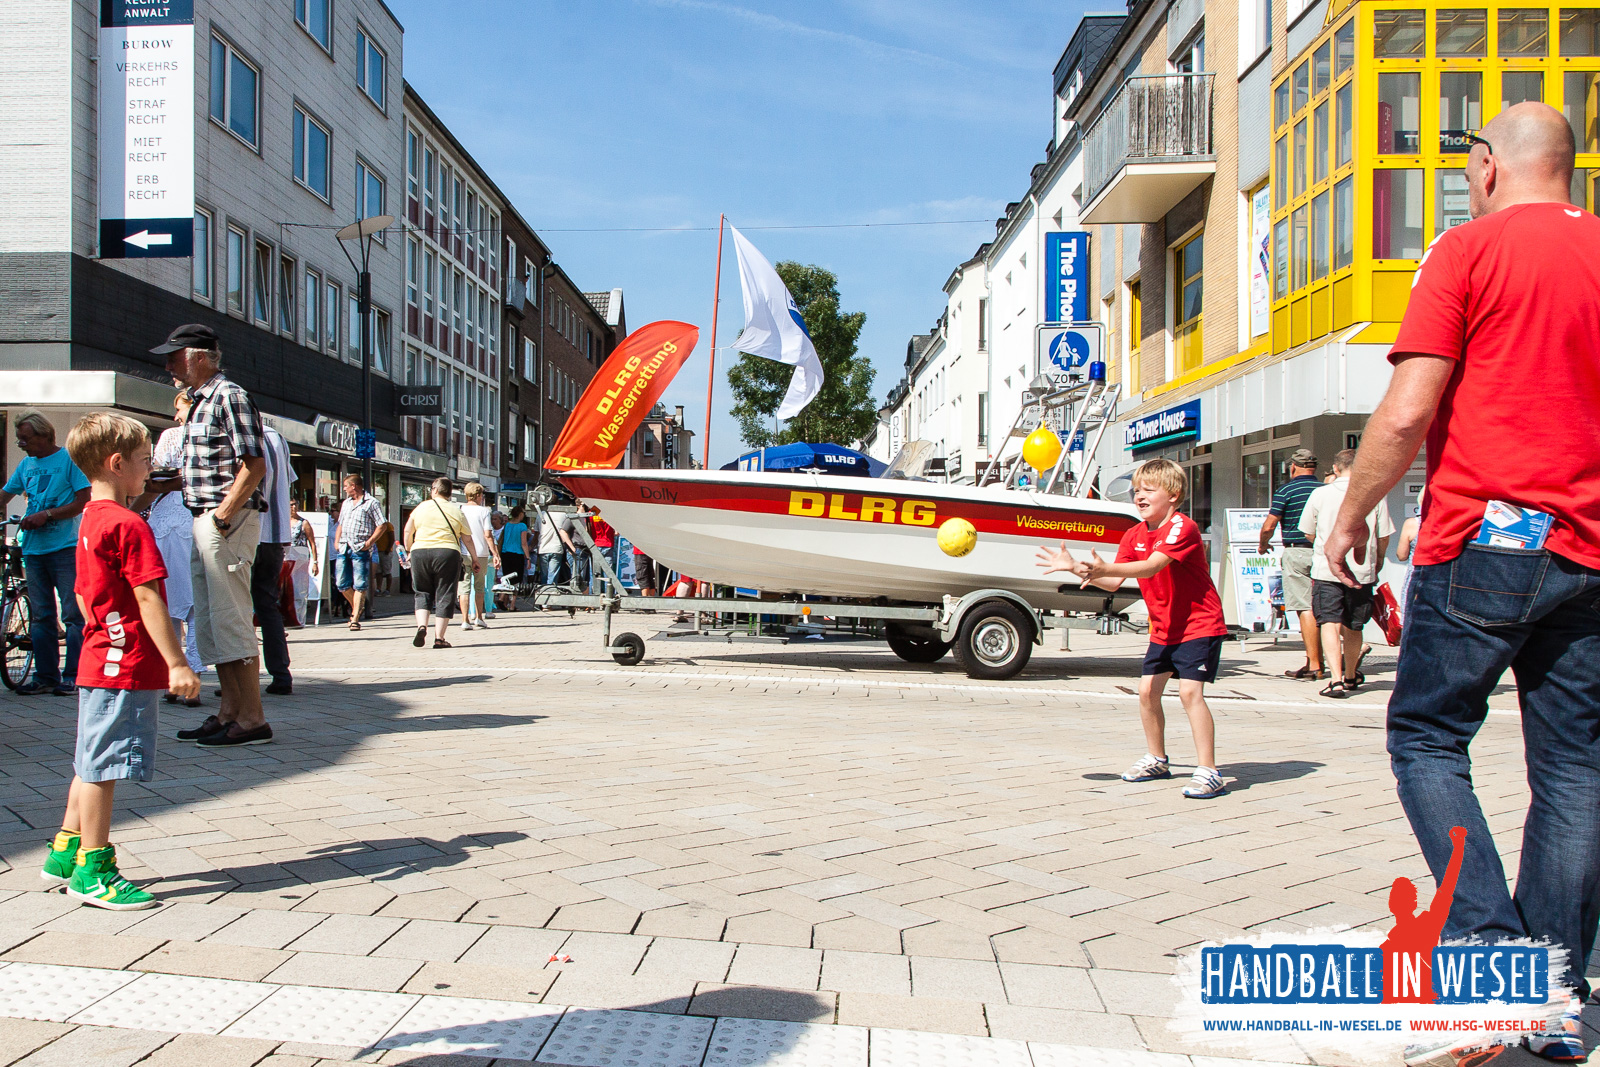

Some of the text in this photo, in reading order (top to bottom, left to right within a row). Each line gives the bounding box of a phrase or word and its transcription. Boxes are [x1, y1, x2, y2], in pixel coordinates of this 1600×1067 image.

[124, 8, 171, 18] ANWALT
[122, 40, 173, 50] BUROW
[116, 61, 178, 72] VERKEHRS
[129, 77, 167, 87] RECHT
[129, 99, 166, 109] STRAF
[129, 114, 167, 124] RECHT
[134, 137, 162, 147] MIET
[129, 152, 167, 162] RECHT
[137, 175, 159, 184] ERB
[129, 190, 167, 200] RECHT
[1060, 238, 1077, 276] The
[596, 355, 641, 415] DLRG
[400, 394, 439, 406] CHRIST
[594, 341, 678, 449] Wasserrettung
[1124, 411, 1186, 444] The Phone House
[824, 454, 856, 465] DLRG
[640, 486, 678, 503] Dolly
[788, 491, 937, 526] DLRG
[1016, 515, 1105, 537] Wasserrettung
[1246, 558, 1277, 567] NIMM 2
[1242, 567, 1260, 575] ZAHL
